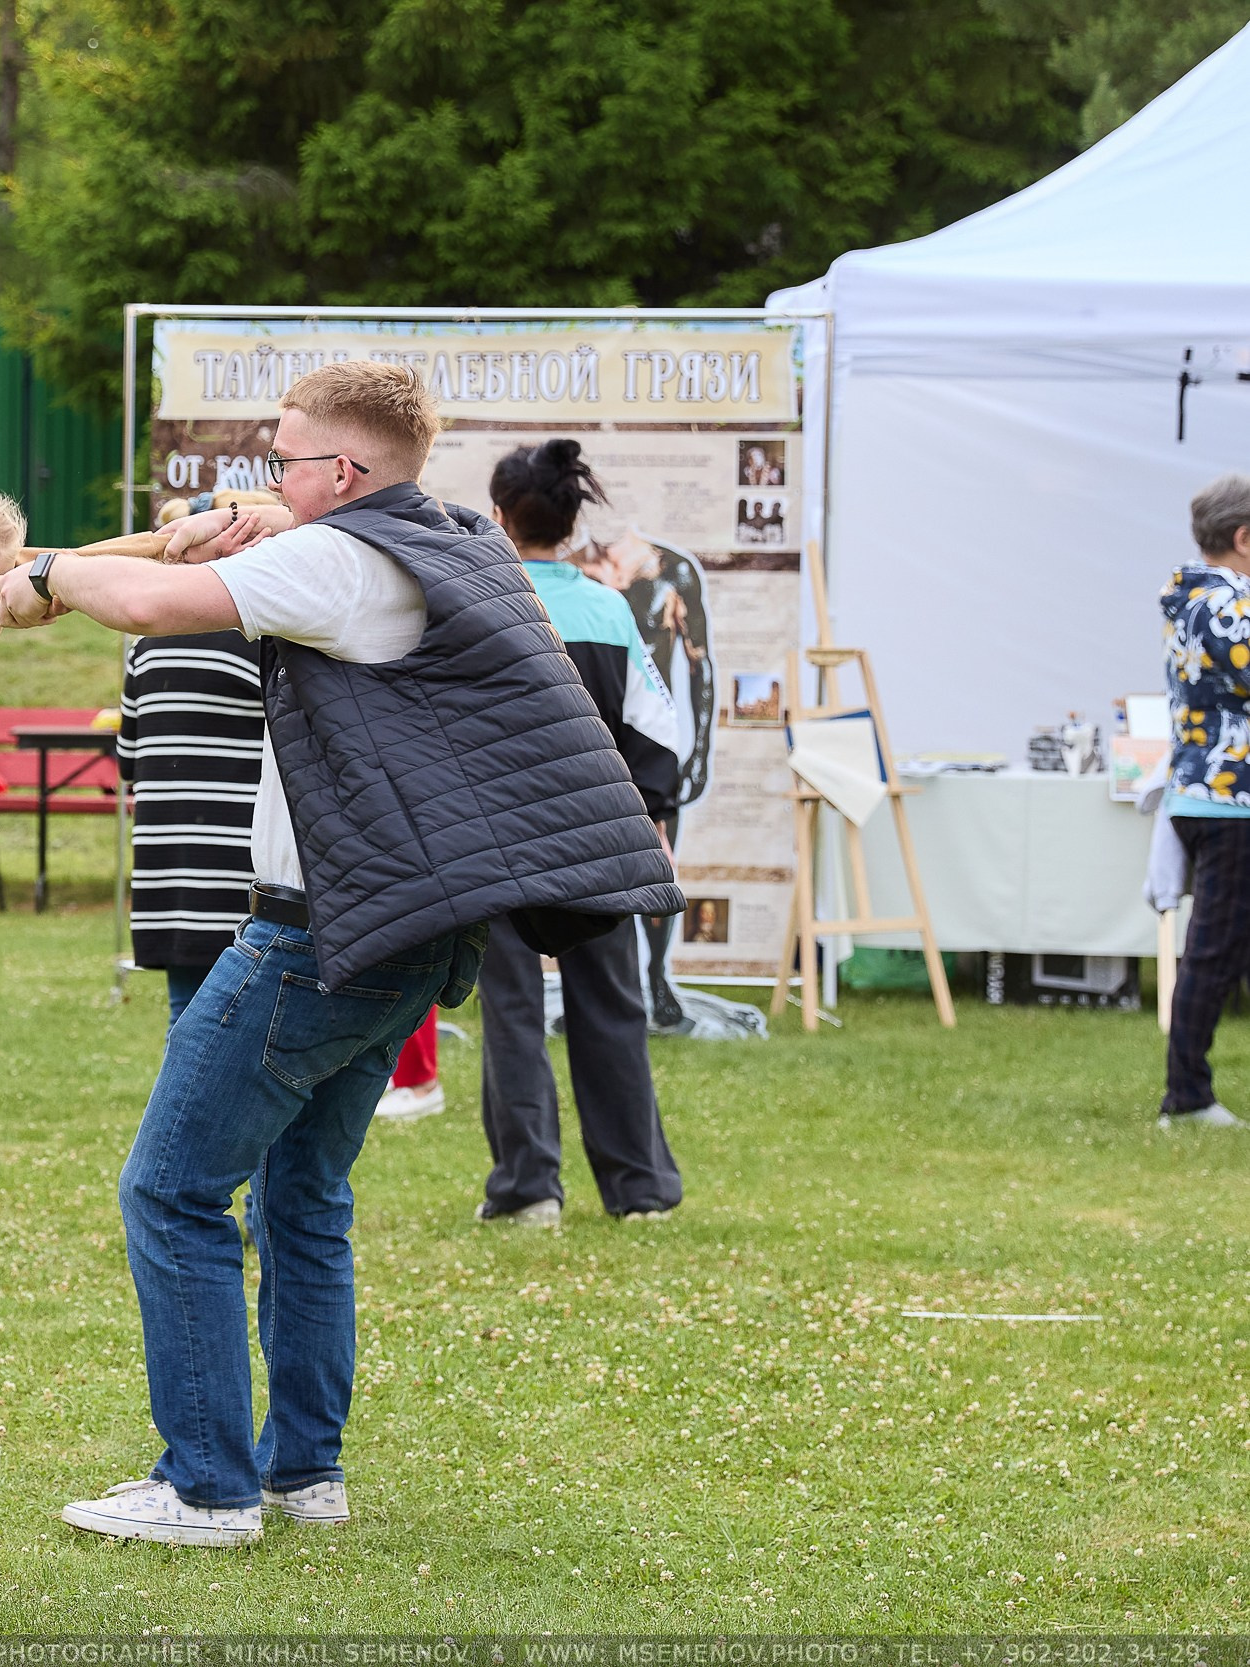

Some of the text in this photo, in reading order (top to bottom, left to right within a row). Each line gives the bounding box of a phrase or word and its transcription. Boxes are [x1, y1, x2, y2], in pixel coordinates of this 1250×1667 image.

[195, 343, 348, 401] ТАЙН
[623, 351, 762, 402] ГРЯЗИ
[167, 455, 204, 488] ОТ
